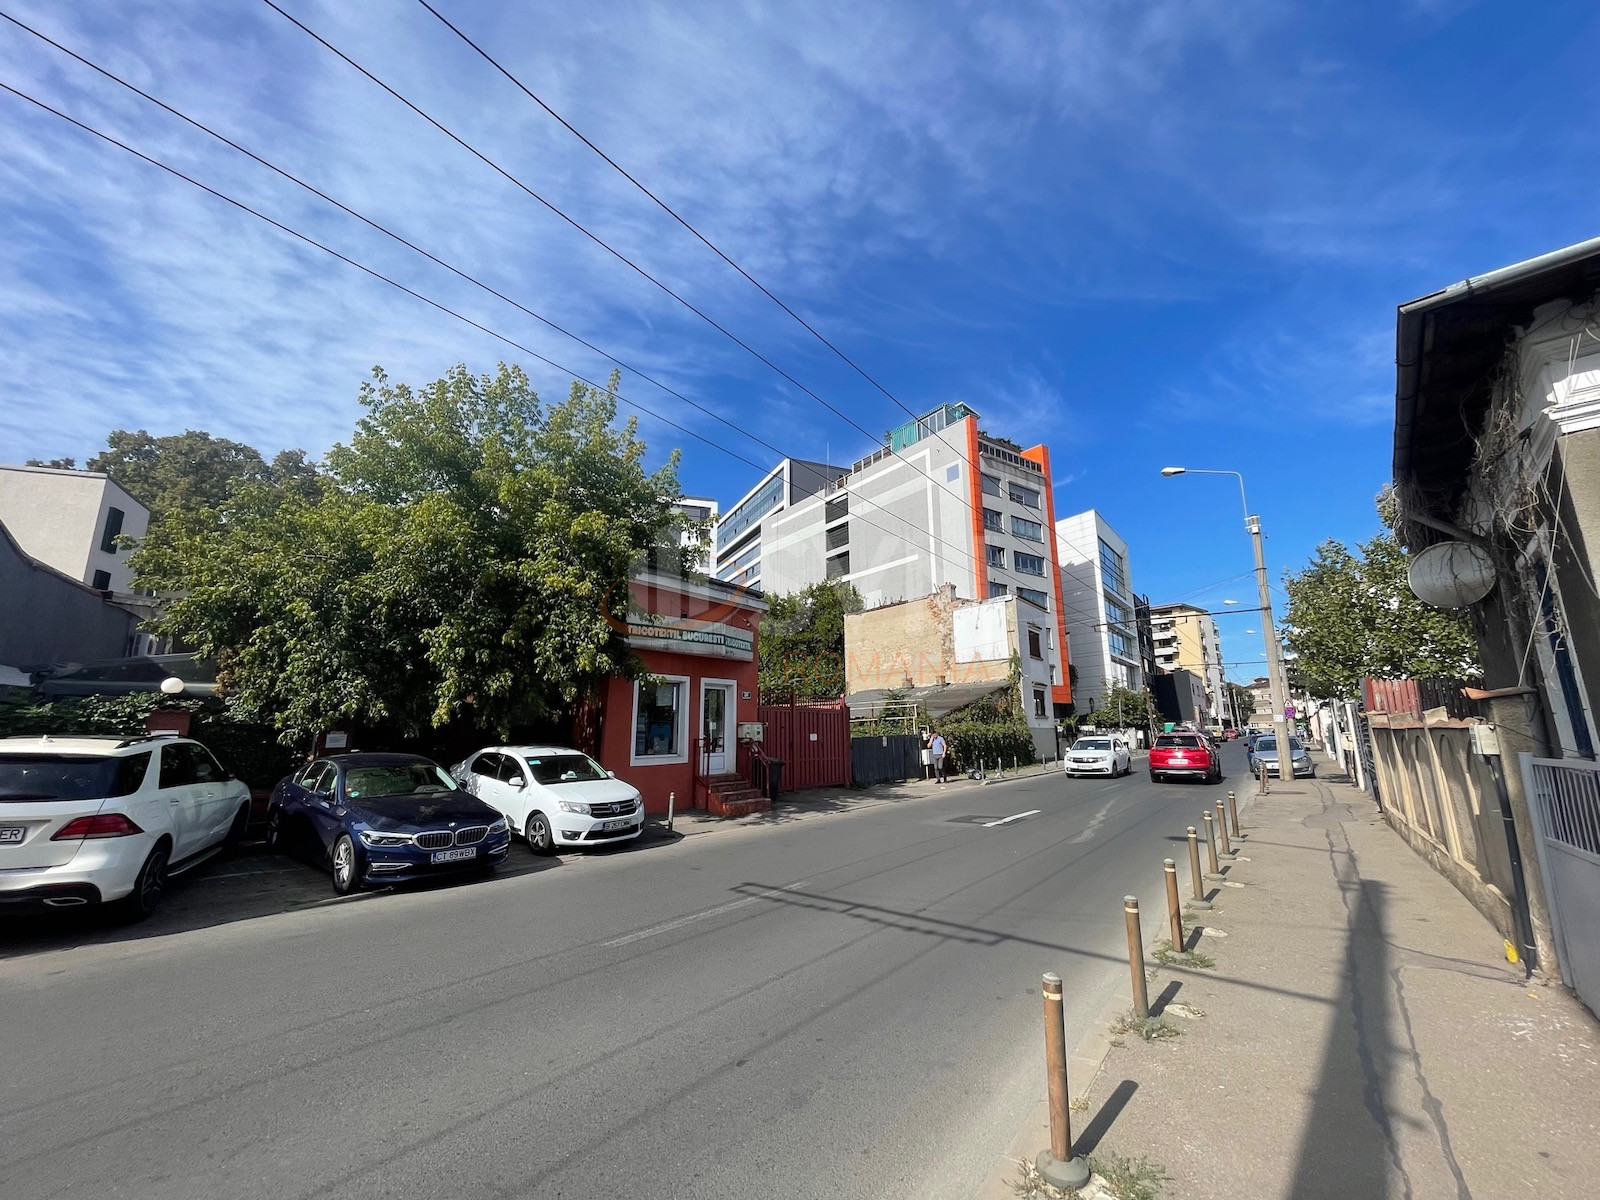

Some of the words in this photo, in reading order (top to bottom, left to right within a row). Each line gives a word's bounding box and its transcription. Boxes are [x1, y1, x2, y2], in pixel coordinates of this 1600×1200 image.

[627, 624, 682, 640] TRICOTEXTIL
[682, 631, 725, 645] BUCURESTI
[437, 852, 446, 860] CT
